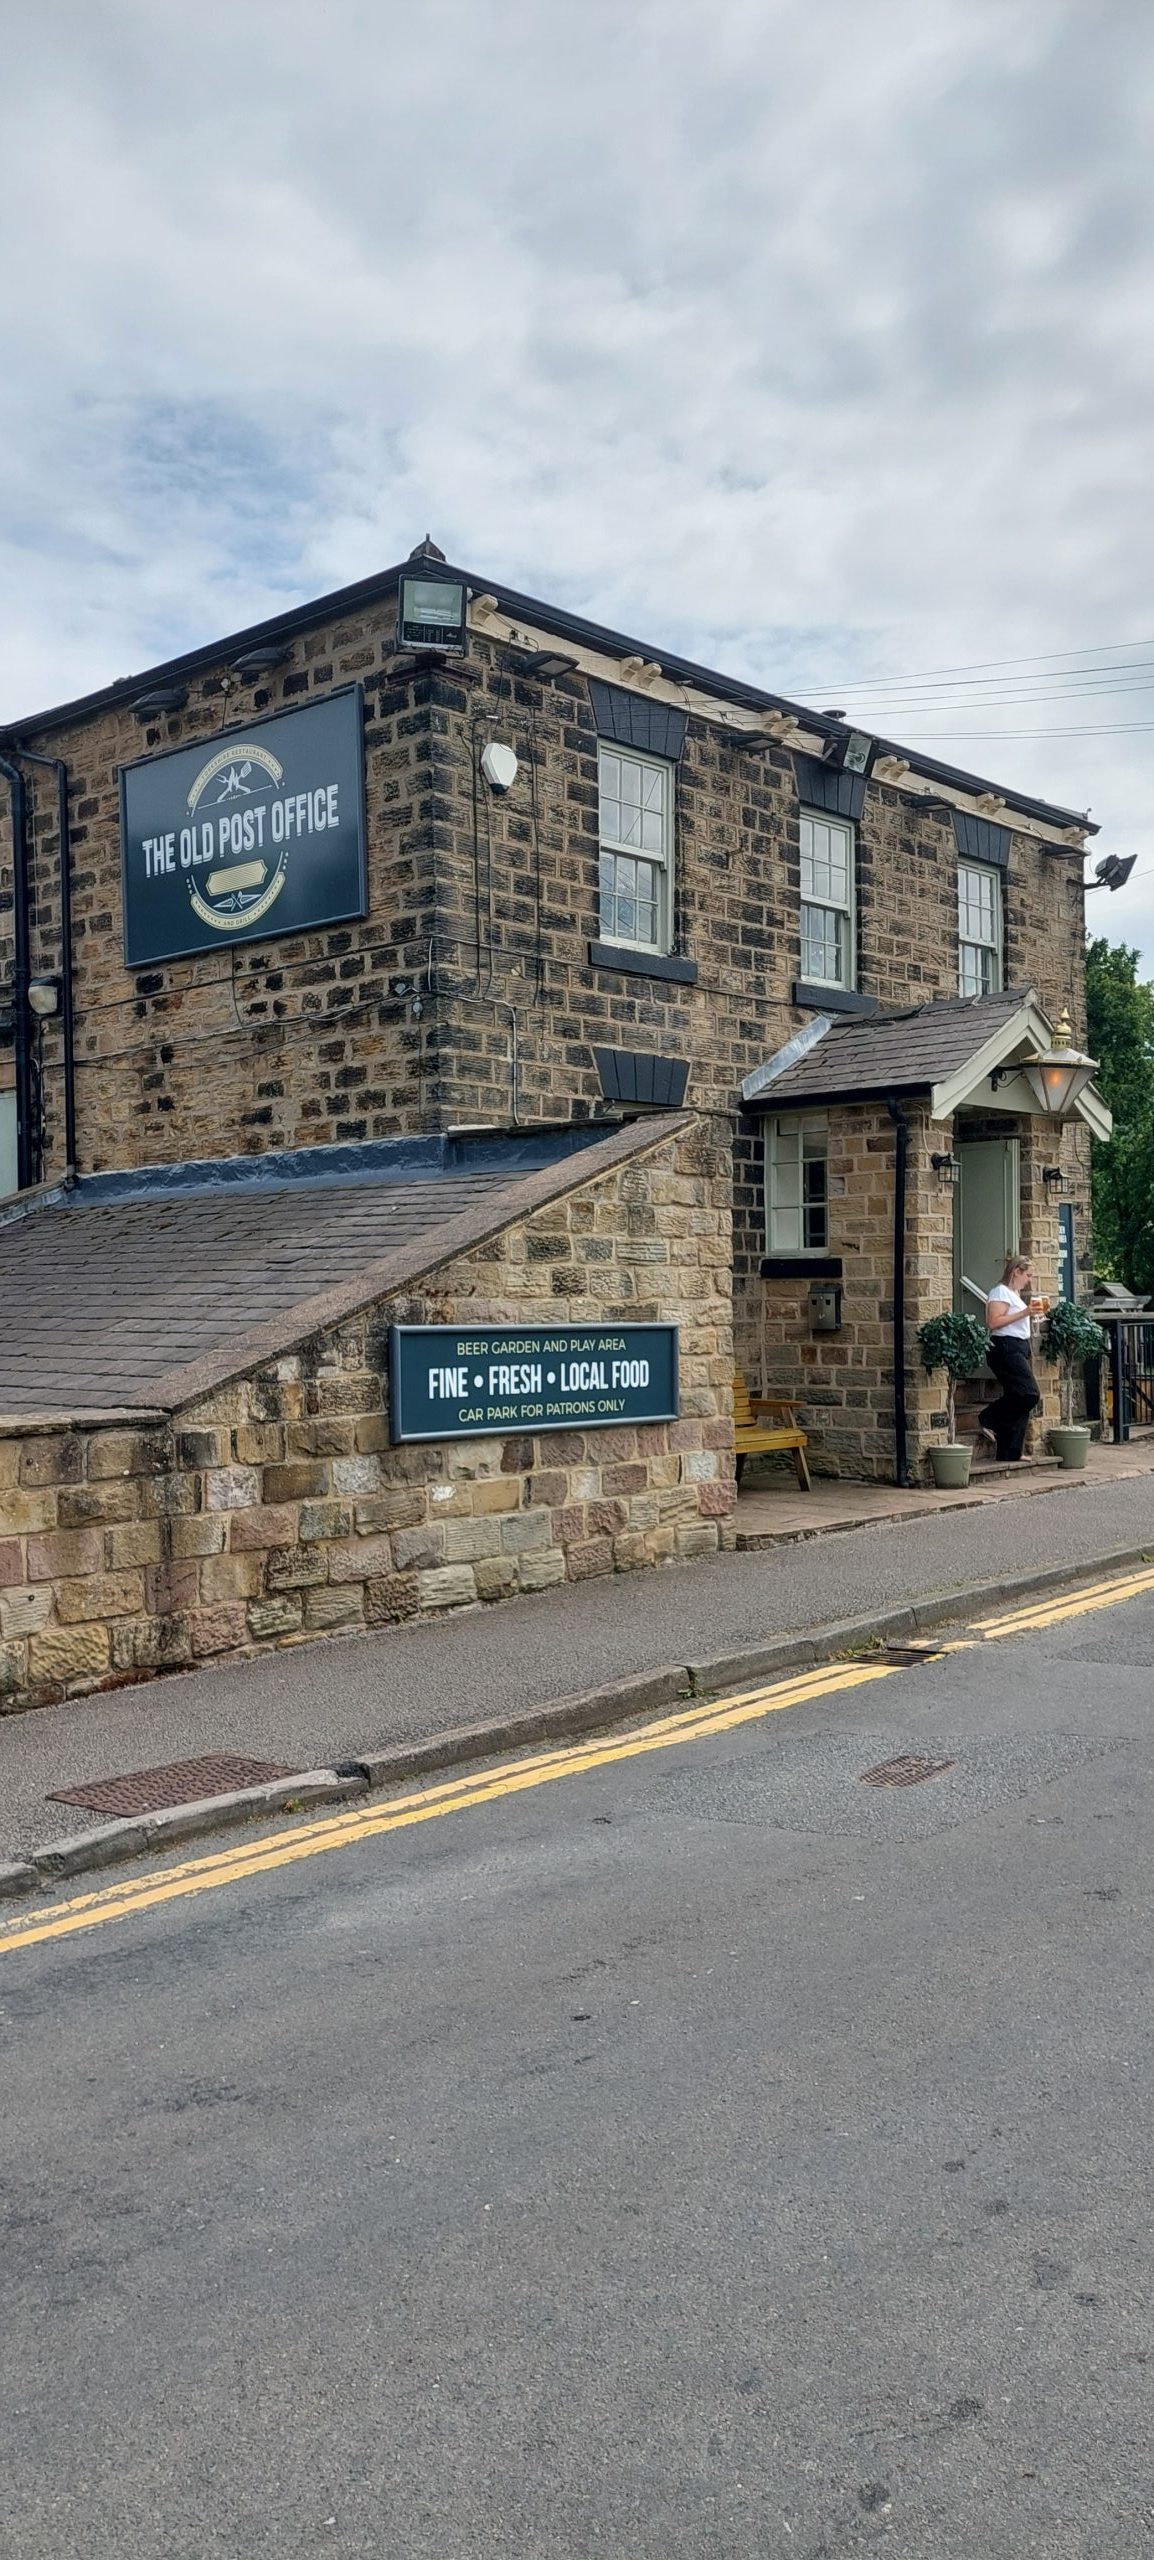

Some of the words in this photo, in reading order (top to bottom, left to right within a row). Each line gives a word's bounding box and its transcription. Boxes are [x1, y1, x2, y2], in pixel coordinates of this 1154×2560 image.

[231, 747, 267, 760] RESTAURANT
[142, 832, 176, 878] THE
[180, 822, 214, 868] OLD
[219, 805, 267, 858] POST
[271, 784, 339, 843] OFFICE
[223, 919, 235, 927] AND
[457, 1342, 488, 1356] BEER
[491, 1340, 540, 1355] GARDEN
[542, 1339, 568, 1353] AND
[570, 1338, 596, 1352] PLAY
[598, 1338, 626, 1351] AREA
[429, 1367, 468, 1399] FINE
[489, 1364, 541, 1395] FRESH
[560, 1361, 609, 1392] LOCAL
[613, 1360, 649, 1388] FOOD
[458, 1407, 484, 1422] CAR
[487, 1405, 518, 1420] PARK
[521, 1403, 543, 1417] FOR
[546, 1400, 595, 1417] PATRONS
[598, 1399, 626, 1412] ONLY
